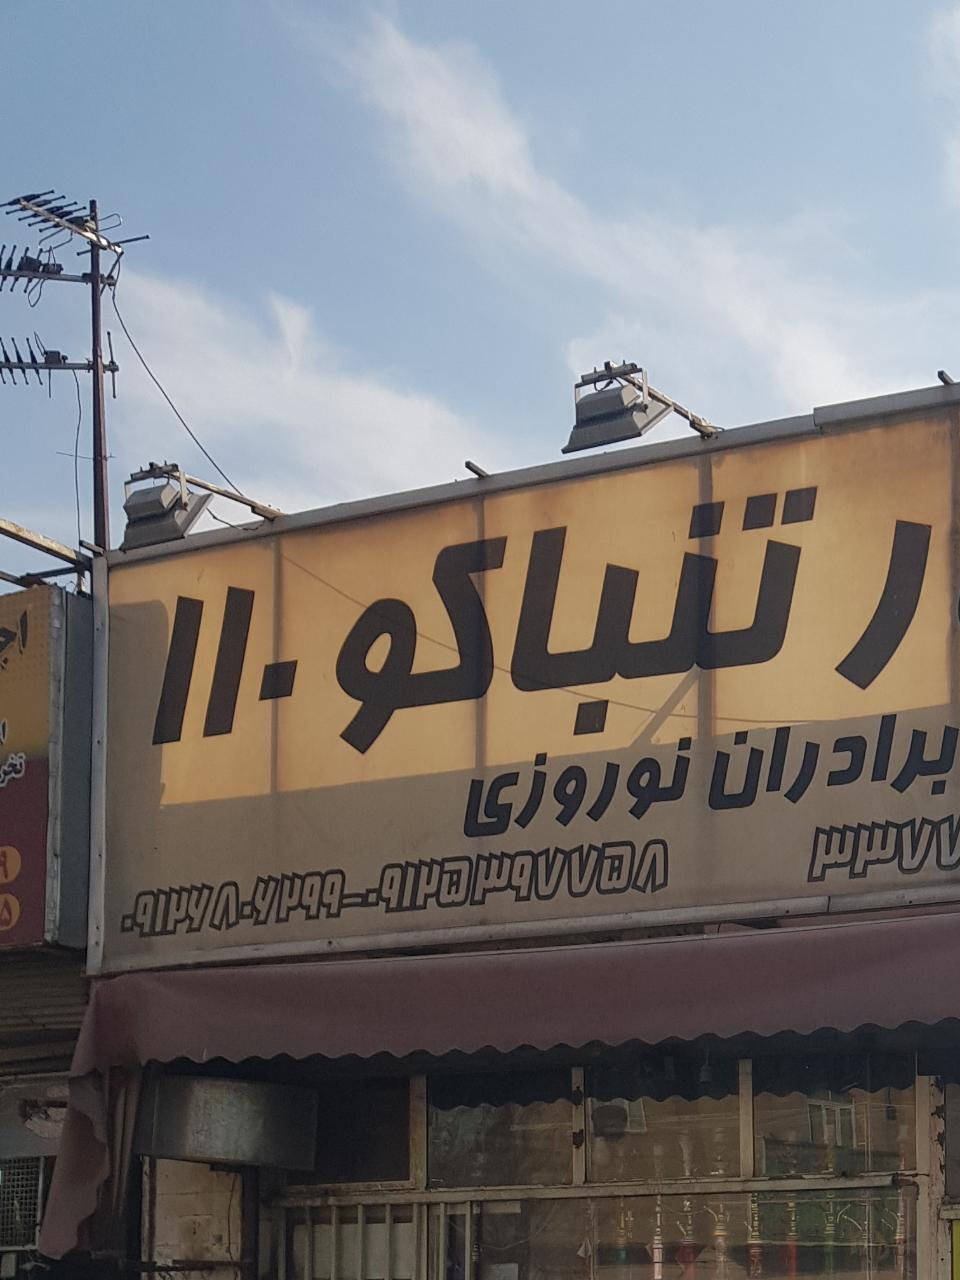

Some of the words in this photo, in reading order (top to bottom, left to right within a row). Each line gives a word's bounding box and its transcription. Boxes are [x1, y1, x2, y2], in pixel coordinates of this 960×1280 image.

[335, 486, 817, 754] تنباکو
[463, 737, 692, 838] نوروزی
[708, 714, 959, 811] برادران
